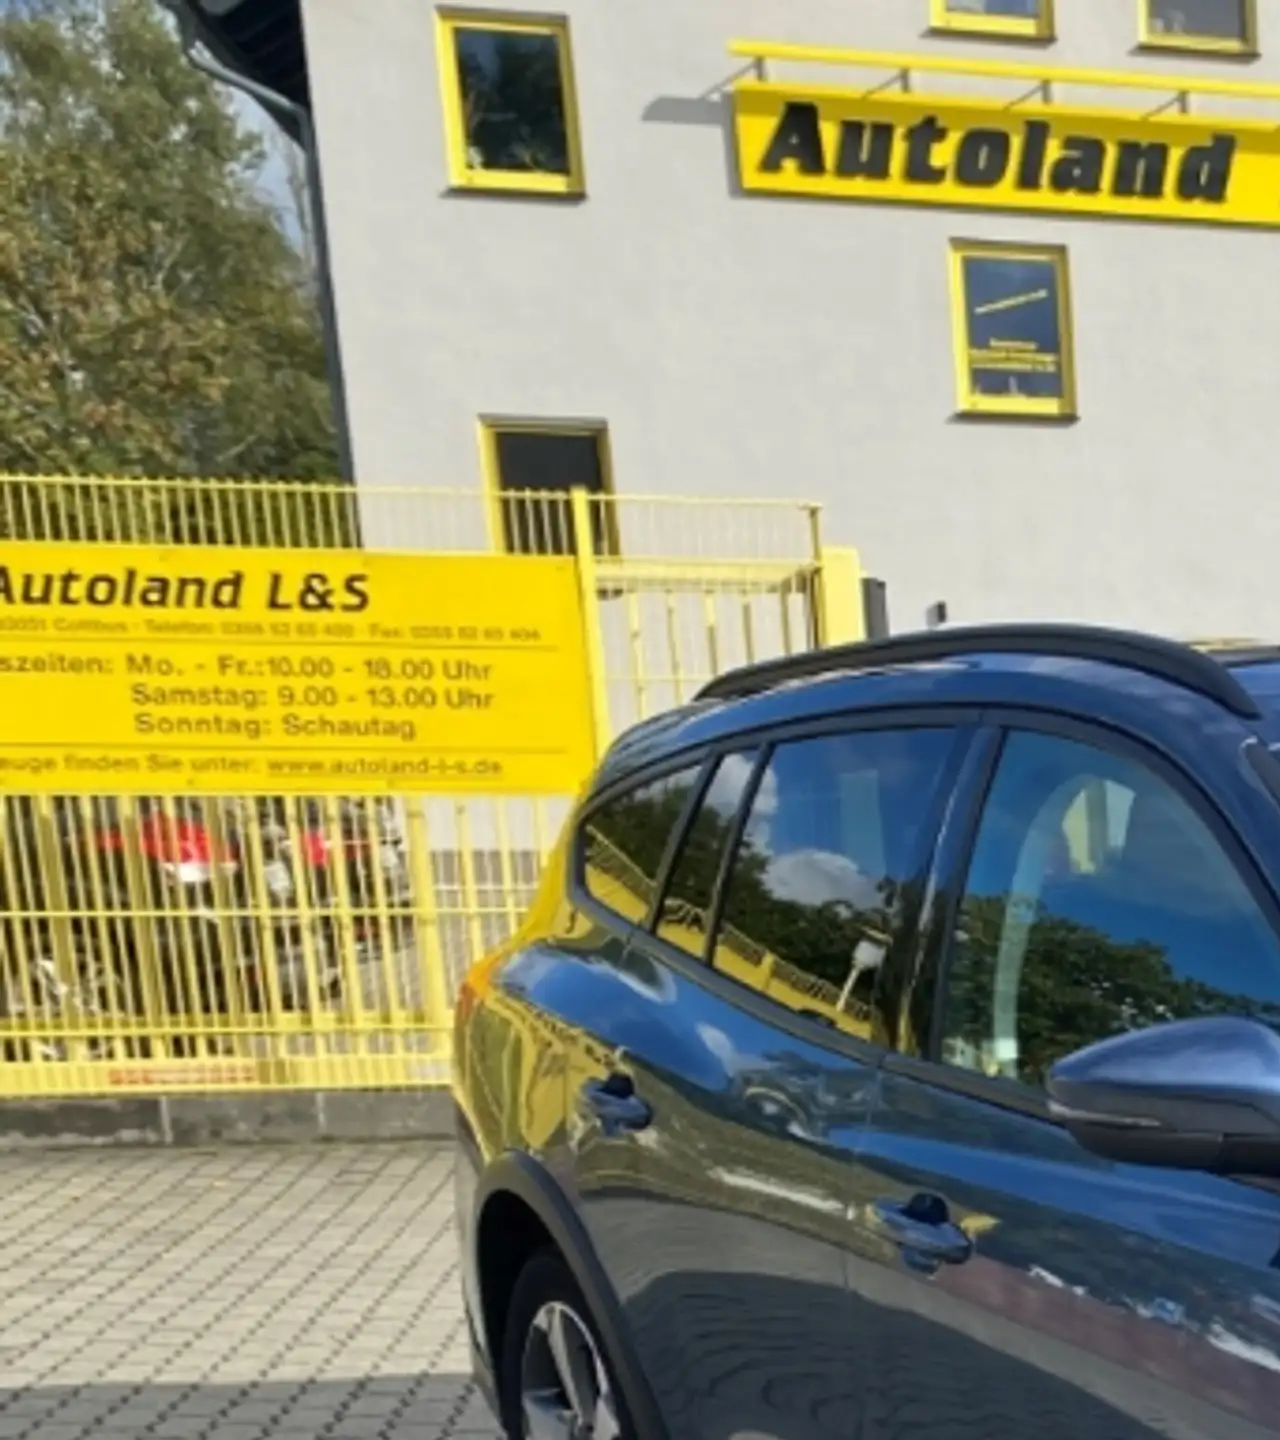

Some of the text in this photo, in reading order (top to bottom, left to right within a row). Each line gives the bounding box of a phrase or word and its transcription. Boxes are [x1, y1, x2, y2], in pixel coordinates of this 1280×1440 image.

[757, 101, 1238, 203] Autoland
[266, 571, 370, 613] L&S
[126, 653, 184, 676] Mo.
[442, 658, 493, 681] Uhr
[131, 682, 267, 711] Samstag:
[278, 685, 338, 708] 9.00
[366, 687, 438, 709] 13.00
[444, 688, 495, 710] Uhr
[134, 712, 416, 741] Sonntag: Schautag
[63, 754, 140, 772] finden
[146, 755, 183, 773] Sie
